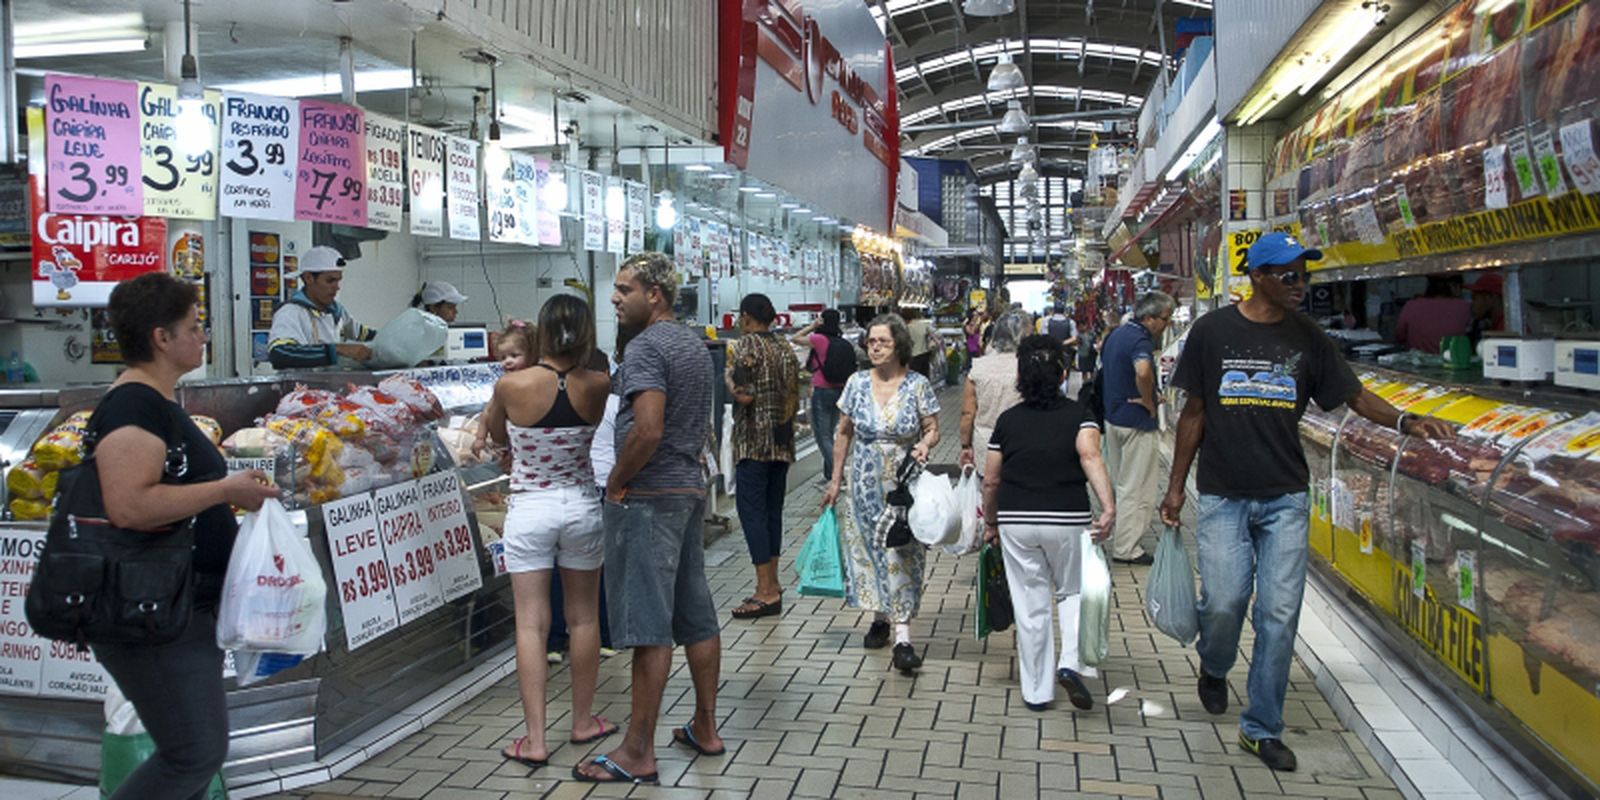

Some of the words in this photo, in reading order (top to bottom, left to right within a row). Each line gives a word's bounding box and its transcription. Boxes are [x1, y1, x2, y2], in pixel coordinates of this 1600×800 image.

[227, 98, 290, 124] FRANGO
[303, 107, 360, 135] FRANGO
[63, 140, 104, 158] LEVE
[226, 139, 285, 176] 3,99
[380, 148, 399, 169] 1,99
[410, 130, 443, 163] TEMOS
[58, 162, 128, 202] 3,99
[142, 146, 213, 191] 3,99
[452, 171, 471, 184] ASA
[310, 169, 362, 210] 7,99
[380, 185, 400, 207] 3,99
[37, 213, 140, 252] Caipira
[255, 459, 274, 472] LEVE
[422, 475, 457, 499] FRANGO
[329, 500, 373, 527] GALINHA
[377, 488, 418, 515] GALINHA
[428, 499, 461, 523] INTEIRO
[383, 511, 424, 545] CAIPIRA
[335, 529, 377, 557] LEVE
[405, 546, 434, 581] 3,99
[356, 560, 388, 597] 3,99
